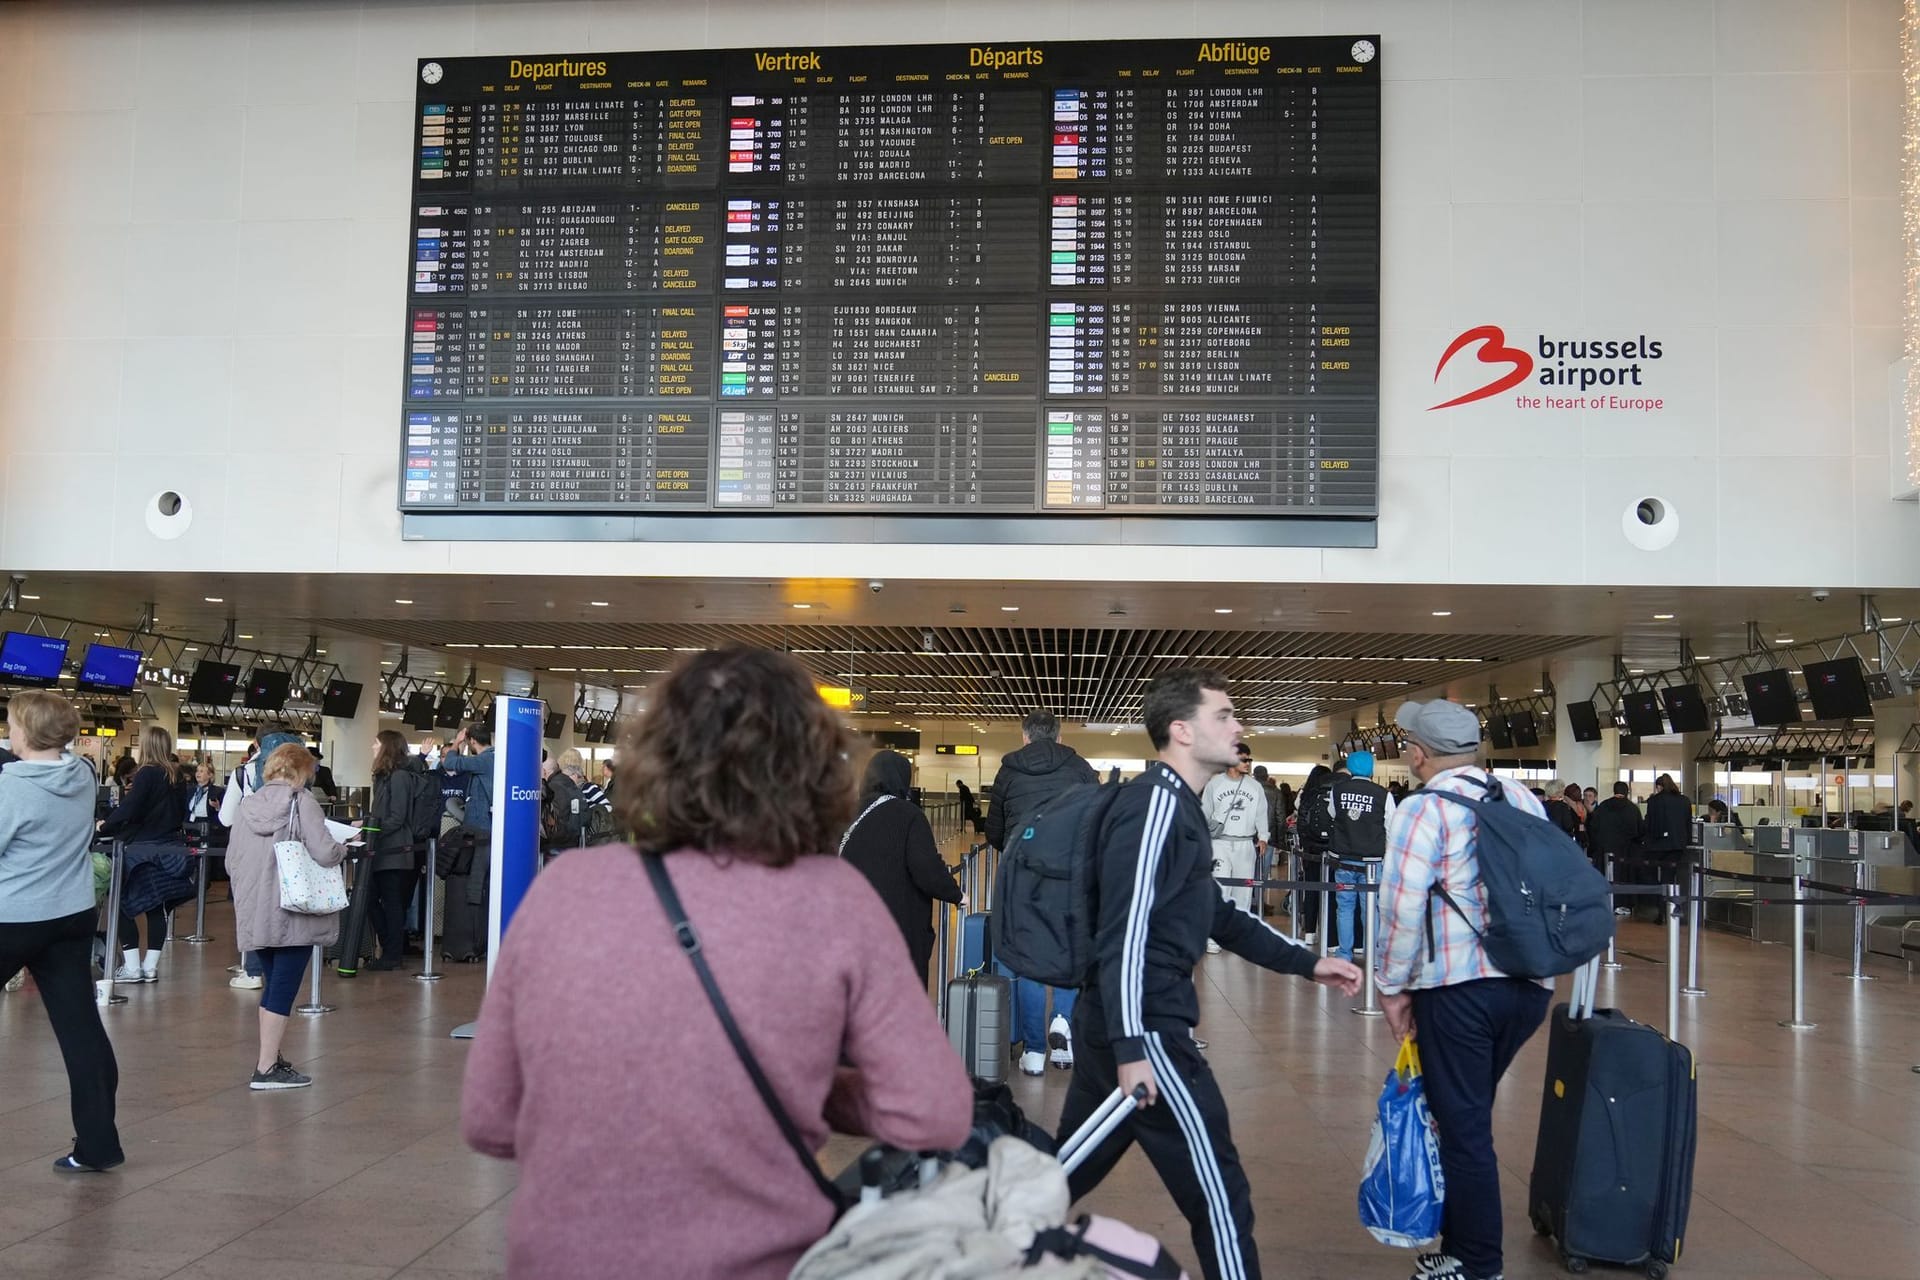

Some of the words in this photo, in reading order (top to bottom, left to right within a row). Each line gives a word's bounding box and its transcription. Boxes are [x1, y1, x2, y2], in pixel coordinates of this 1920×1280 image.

[970, 47, 1043, 69] Départs
[1198, 43, 1270, 65] Abflüge
[755, 52, 821, 71] Vertrek
[510, 60, 607, 79] Departures
[1248, 88, 1263, 96] LHR
[881, 94, 911, 102] LONDON
[565, 101, 591, 109] MILAN
[595, 100, 624, 109] LINATE
[669, 99, 695, 107] DELAYED
[1210, 100, 1258, 108] AMSTERDAM
[669, 110, 685, 118] GATE
[686, 110, 701, 118] OPEN
[1210, 111, 1241, 119] VIENNA
[1209, 122, 1230, 130] DOHA
[880, 127, 931, 135] WASHINGTON
[564, 134, 603, 142] TOULOUSE
[1209, 134, 1235, 142] DUBAI
[563, 145, 599, 153] CHICAGO
[1209, 145, 1252, 153] BUDAPEST
[1209, 156, 1241, 164] GENEVA
[667, 165, 696, 173] BOARDING
[1209, 168, 1252, 176] ALICANTE
[879, 172, 925, 180] BARCELONA
[666, 203, 699, 211] CANCELLED
[1209, 207, 1257, 215] BARCELONA
[877, 211, 914, 219] BEIJING
[561, 216, 614, 224] OUAGADOUGOU
[1209, 219, 1262, 227] COPENHAGEN
[877, 222, 913, 230] CONAKRY
[560, 227, 584, 235] PORTO
[560, 238, 589, 246] ZAGREB
[682, 236, 703, 244] CLOSED
[877, 233, 907, 241] BANJUL
[1209, 253, 1245, 261] BOLOGNA
[663, 270, 688, 278] DELAYED
[877, 267, 918, 275] FREETOWN
[876, 278, 907, 286] MUNICH
[1208, 304, 1240, 312] VIENNA
[557, 321, 581, 329] ACCRA
[875, 317, 911, 325] BANGKOK
[1207, 327, 1261, 335] COPENHAGEN
[1322, 327, 1349, 335] DELAYED
[556, 332, 586, 340] ATHENS
[874, 340, 920, 348] BUCHAREST
[1539, 335, 1662, 359] brussels
[555, 354, 594, 362] SHANGHAI
[1207, 350, 1239, 358] BERLIN
[555, 365, 589, 373] TANGIER
[1207, 362, 1239, 370] LISBON
[1322, 362, 1349, 370] DELAYED
[554, 376, 574, 384] NICE
[874, 374, 915, 382] TENERIFE
[1540, 361, 1641, 391] airport
[554, 387, 593, 395] HELSINKI
[1517, 397, 1540, 408] the
[1546, 396, 1586, 408] heart
[1591, 396, 1605, 408] of
[1610, 396, 1663, 412] Europe
[659, 414, 675, 422] FINAL
[676, 414, 691, 422] CALL
[552, 426, 597, 434] LJUBLJANA
[872, 425, 908, 433] ALGIERS
[1206, 425, 1238, 433] MALAGA
[552, 437, 581, 445] ATHENS
[551, 448, 571, 456] OSLO
[871, 448, 903, 456] MADRID
[551, 459, 591, 467] ISTANBUL
[1206, 460, 1239, 468] LONDON
[1245, 460, 1259, 468] LHR
[1321, 461, 1349, 469] DELAYED
[674, 470, 688, 478] OPEN
[871, 471, 907, 479] VILNIUS
[1205, 472, 1259, 480] CASABLANCA
[550, 493, 580, 501] LISBON
[870, 494, 912, 502] HURGHADA
[1205, 496, 1254, 504] BARCELONA
[1341, 793, 1373, 804] GUCCI
[1341, 802, 1372, 812] TIGER
